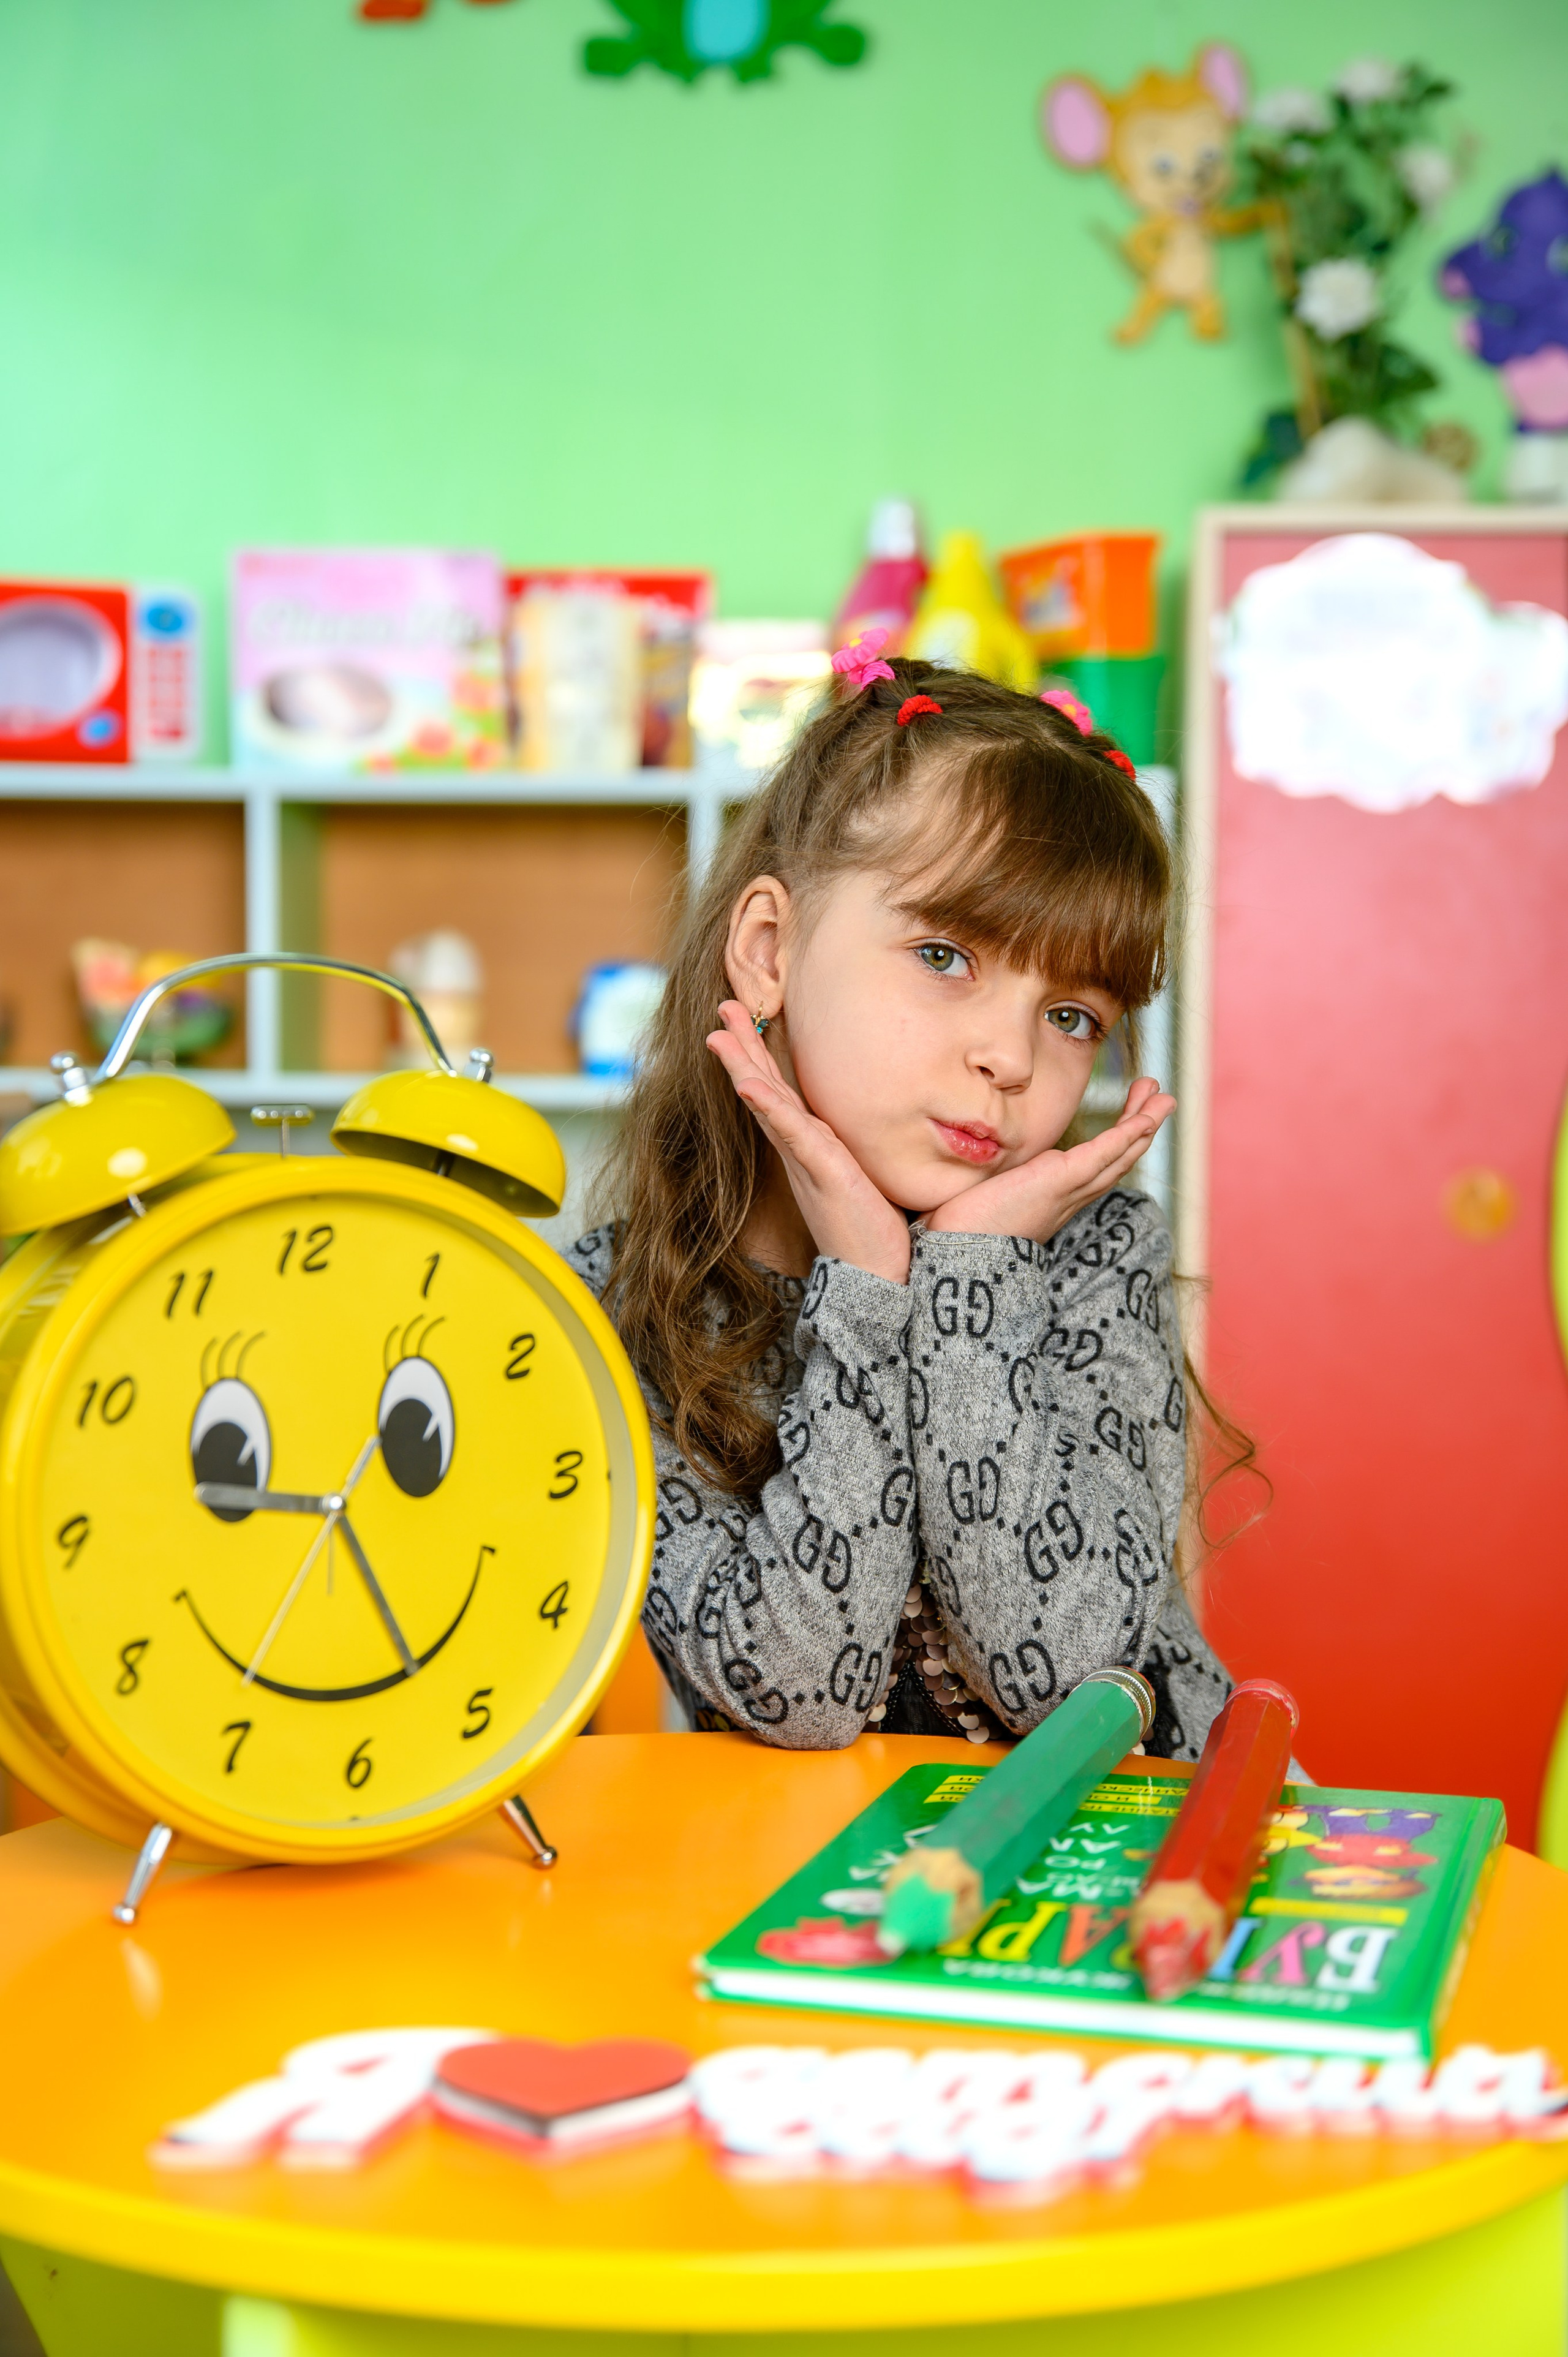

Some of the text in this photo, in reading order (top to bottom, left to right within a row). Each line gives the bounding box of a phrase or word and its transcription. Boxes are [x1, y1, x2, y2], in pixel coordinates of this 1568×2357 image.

[277, 1224, 334, 1275] 12
[165, 1268, 214, 1319] 11
[421, 1252, 441, 1299] 1
[505, 1332, 537, 1380] 2
[77, 1375, 136, 1427] 10
[548, 1449, 584, 1500] 3
[56, 1514, 91, 1569] 9
[538, 1580, 570, 1630] 4
[116, 1638, 149, 1697] 8
[461, 1688, 494, 1740] 5
[221, 1719, 253, 1774] 7
[345, 1738, 374, 1789] 6
[937, 1900, 1400, 1998] БУАР
